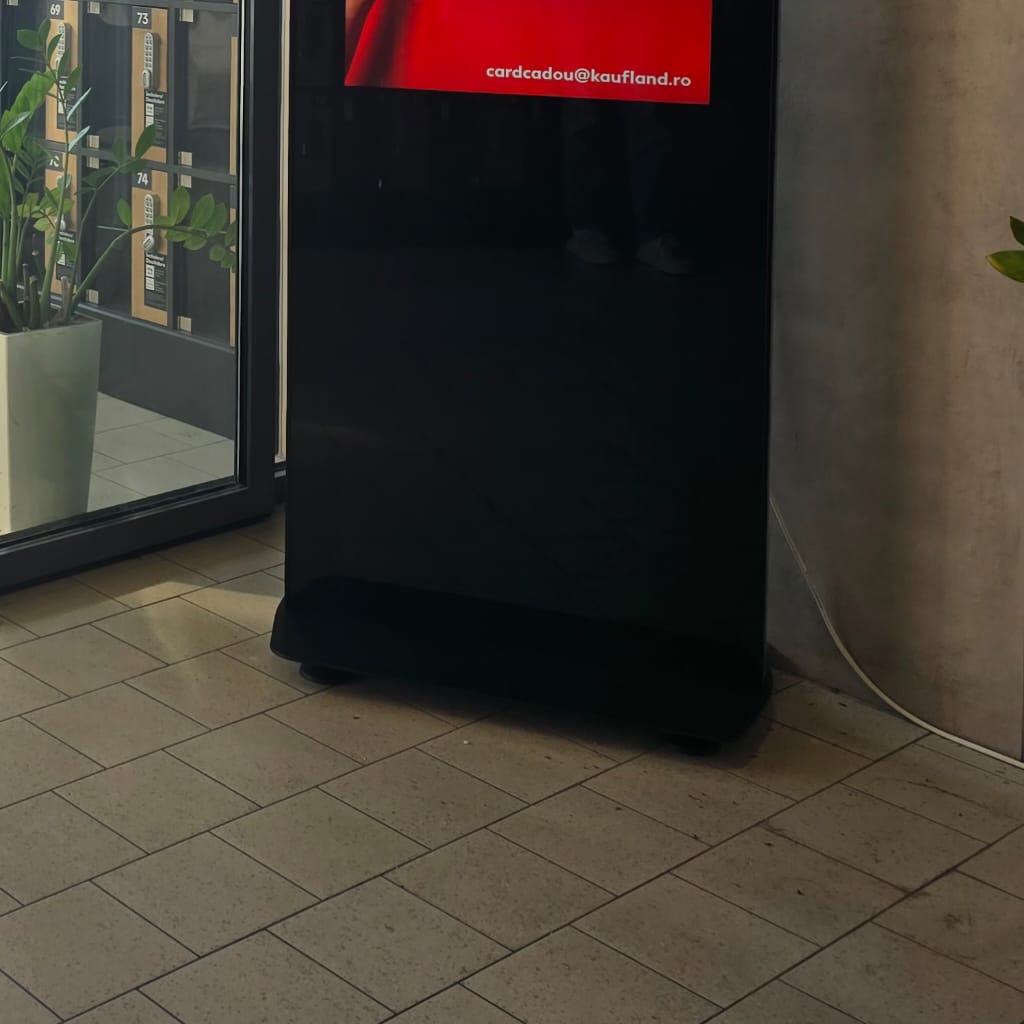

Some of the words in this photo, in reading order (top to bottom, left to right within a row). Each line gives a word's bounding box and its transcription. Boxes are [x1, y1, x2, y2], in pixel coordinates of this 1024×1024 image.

[50, 3, 61, 16] 69
[136, 12, 149, 25] 73
[486, 64, 692, 88] cardcadou@kaufland.ro
[136, 172, 149, 185] 74
